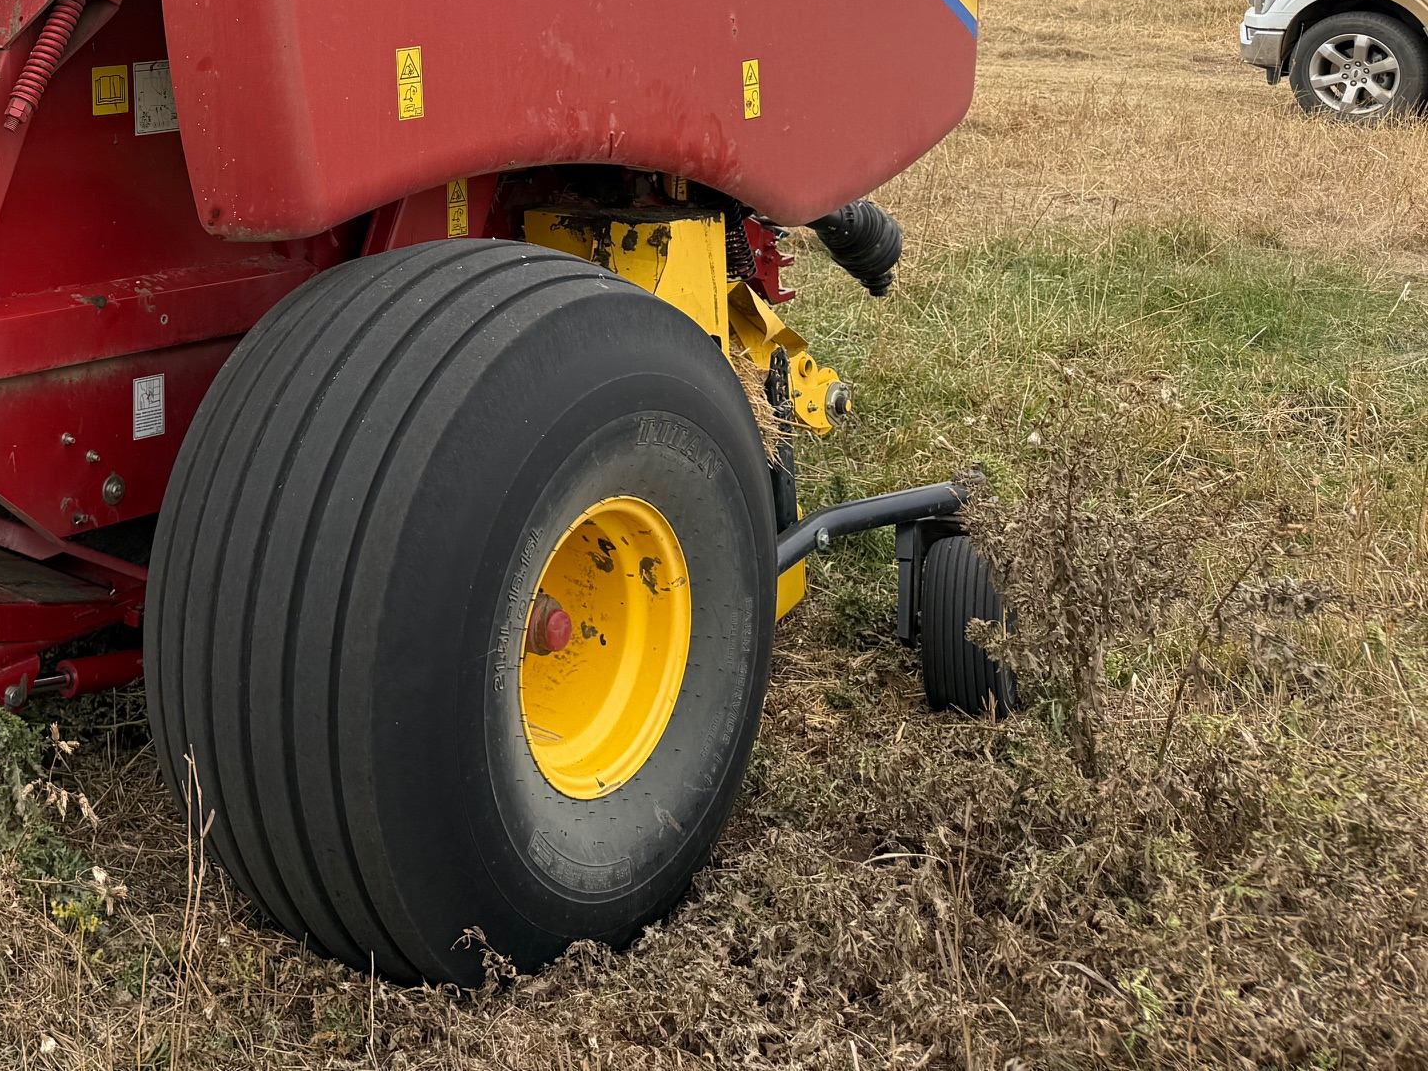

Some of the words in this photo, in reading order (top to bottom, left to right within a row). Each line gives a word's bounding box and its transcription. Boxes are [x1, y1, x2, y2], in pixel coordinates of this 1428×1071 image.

[635, 416, 724, 479] TITAN
[741, 596, 754, 652] FARM
[721, 661, 749, 745] SERVICE
